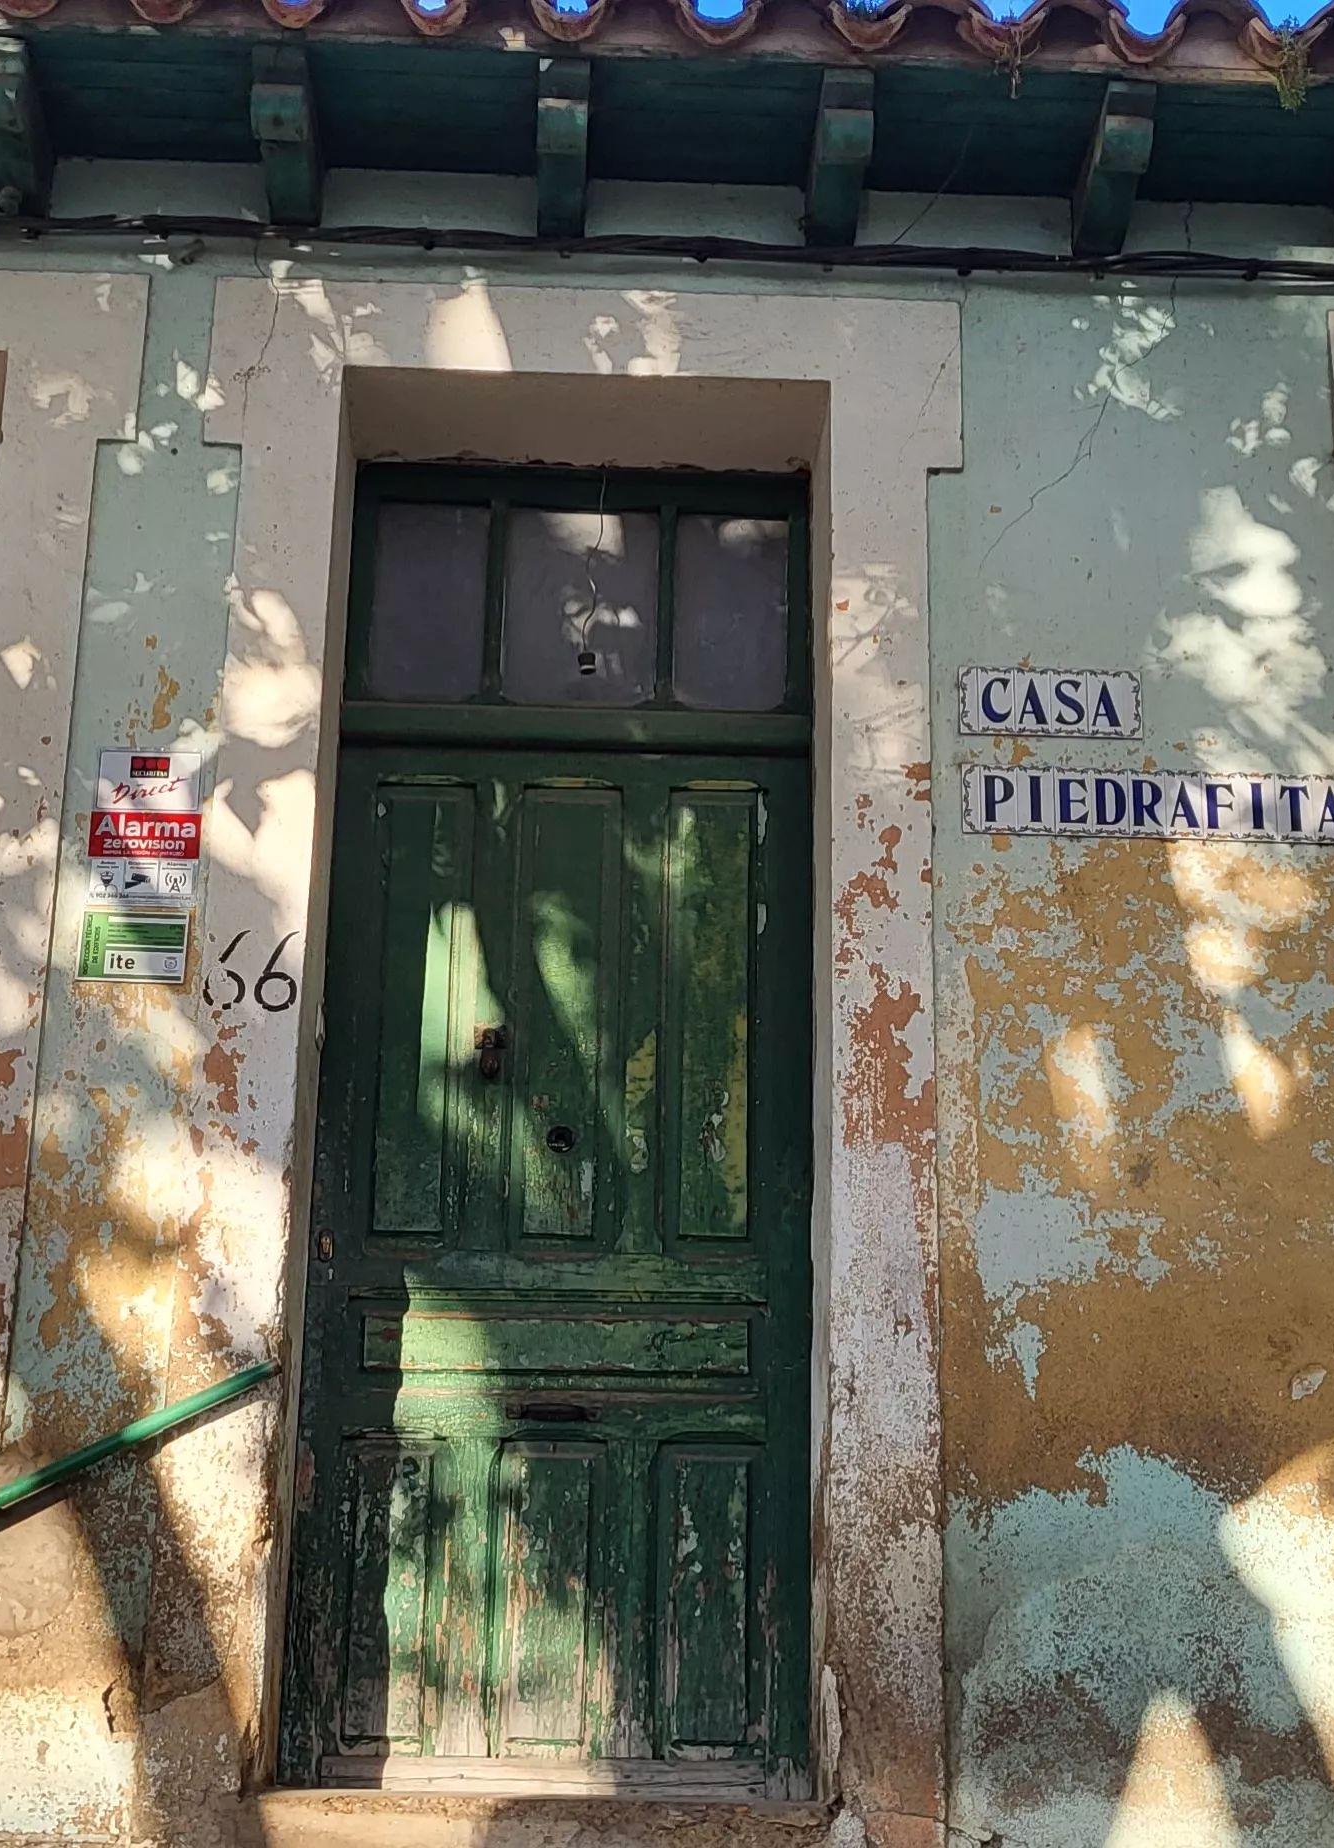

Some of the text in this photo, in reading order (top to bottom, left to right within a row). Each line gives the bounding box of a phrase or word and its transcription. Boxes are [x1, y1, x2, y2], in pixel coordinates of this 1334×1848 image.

[981, 677, 1122, 728] CASA
[111, 776, 190, 805] Direct
[94, 814, 197, 838] Alarma
[103, 838, 185, 851] zerovision
[109, 953, 135, 970] ite
[202, 929, 300, 1013] 66
